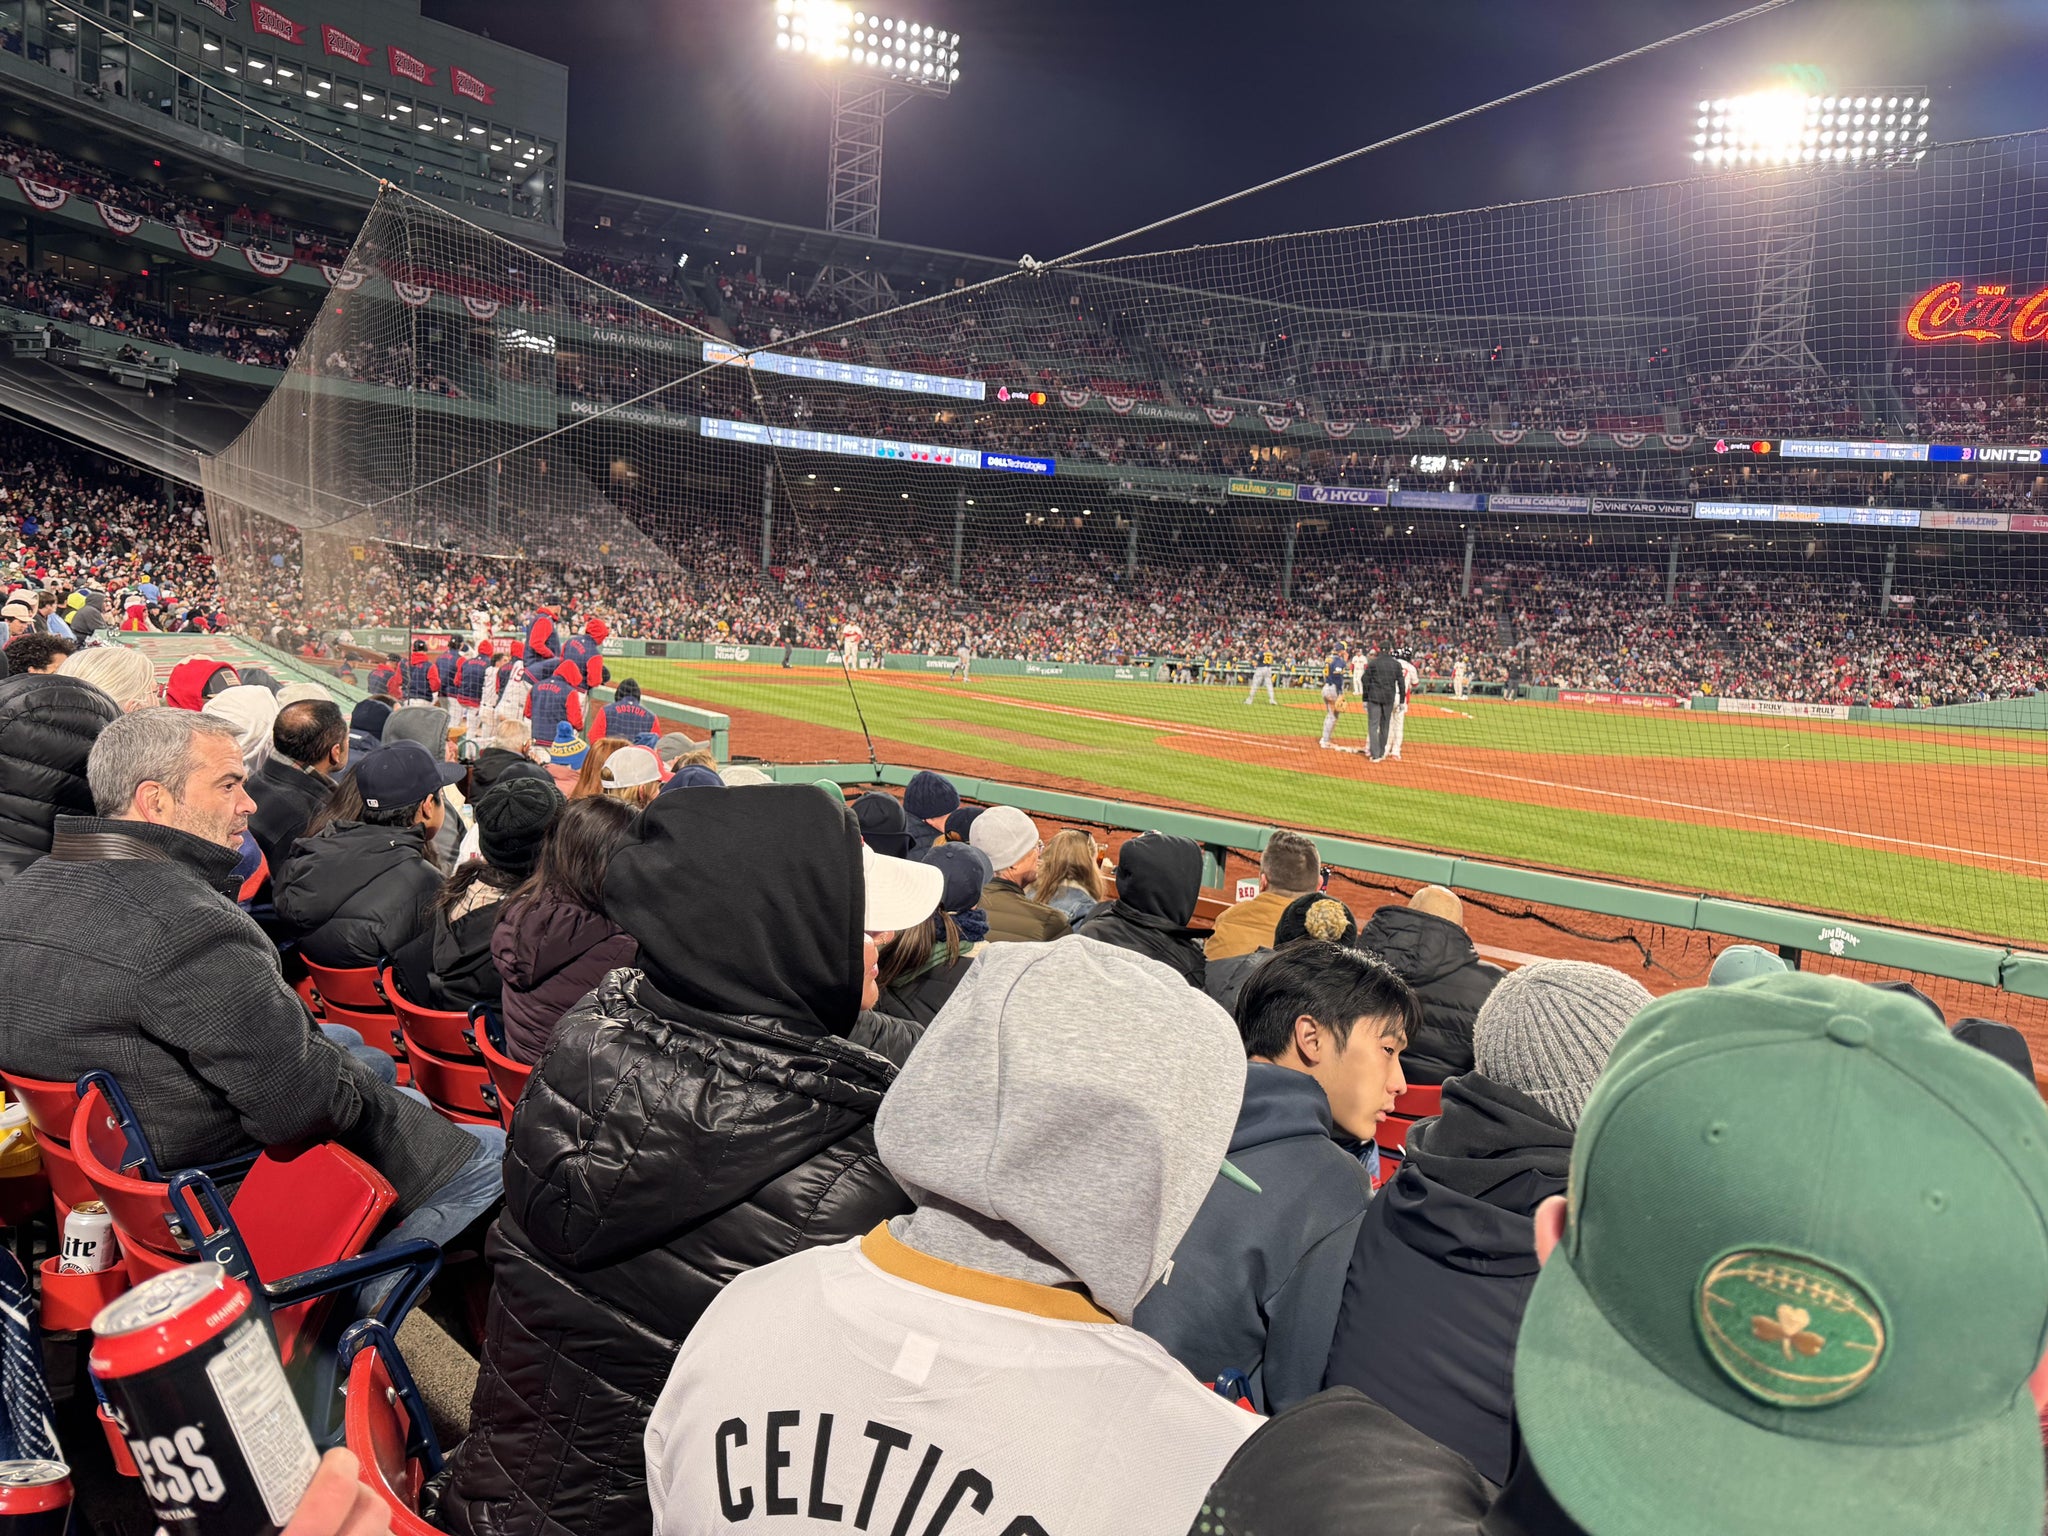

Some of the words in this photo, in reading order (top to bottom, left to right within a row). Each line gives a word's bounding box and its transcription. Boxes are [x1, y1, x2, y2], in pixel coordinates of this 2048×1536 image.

[258, 10, 293, 37] 2004
[328, 33, 361, 57] 2007
[395, 55, 425, 79] 2013
[1977, 286, 2006, 295] ENJOY
[628, 335, 673, 350] PAVILION
[571, 402, 598, 415] DELL
[600, 407, 662, 425] Tchnologies
[664, 414, 687, 427] Level
[1164, 410, 1199, 421] PAVILION
[883, 441, 900, 449] BALL
[1791, 445, 1813, 454] PITCH
[1814, 445, 1840, 454] BREAK
[958, 453, 977, 464] 4TH
[1979, 448, 2042, 462] UNITED
[1231, 483, 1267, 494] SULLIVAN
[1277, 487, 1293, 497] TIRE
[1330, 491, 1369, 502] HYCU
[1491, 496, 1532, 506] COGHLIN
[1533, 497, 1588, 507] COMPANIES
[1604, 503, 1656, 513] VINEYARD
[1658, 505, 1690, 514] VINES
[1699, 507, 1740, 516] CHANGEUP
[1754, 508, 1771, 517] MPH
[537, 683, 562, 694] BOSTON
[615, 704, 646, 718] BOSTON
[1759, 703, 1782, 711] TRULY
[1811, 706, 1835, 714] TRULY
[551, 741, 584, 755] oston
[1818, 928, 1835, 940] JIM
[1834, 927, 1857, 947] BEAM
[216, 1246, 234, 1264] C
[715, 1410, 1050, 1536] CELTIC
